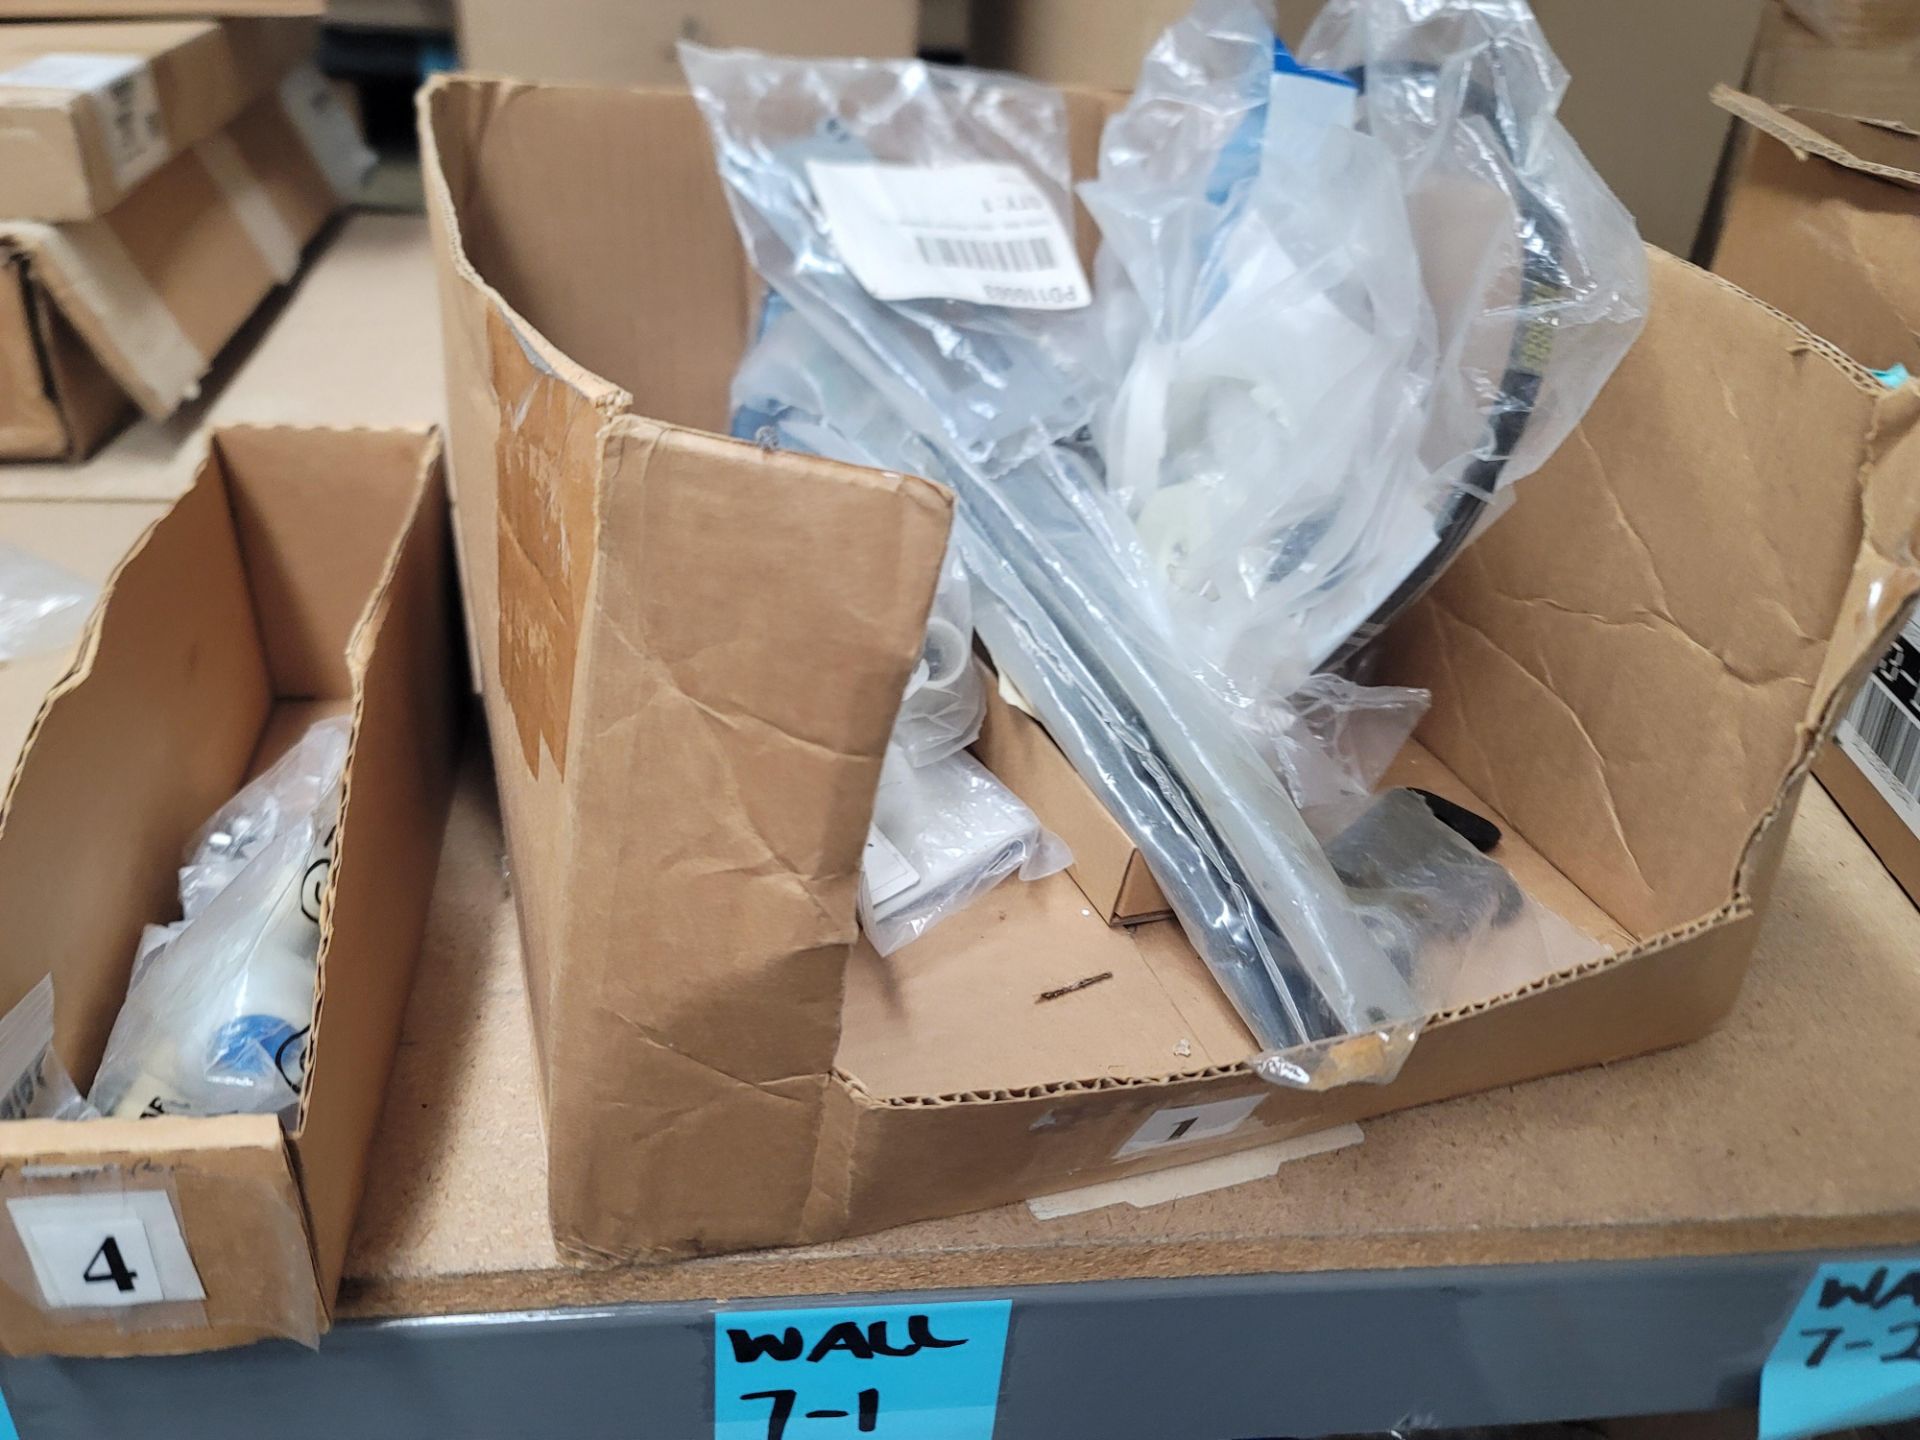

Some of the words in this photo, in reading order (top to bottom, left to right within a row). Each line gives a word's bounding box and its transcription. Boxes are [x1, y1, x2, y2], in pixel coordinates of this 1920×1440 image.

[83, 1236, 138, 1292] 4
[727, 1314, 970, 1363] WALL
[740, 1387, 880, 1440] 7-1
